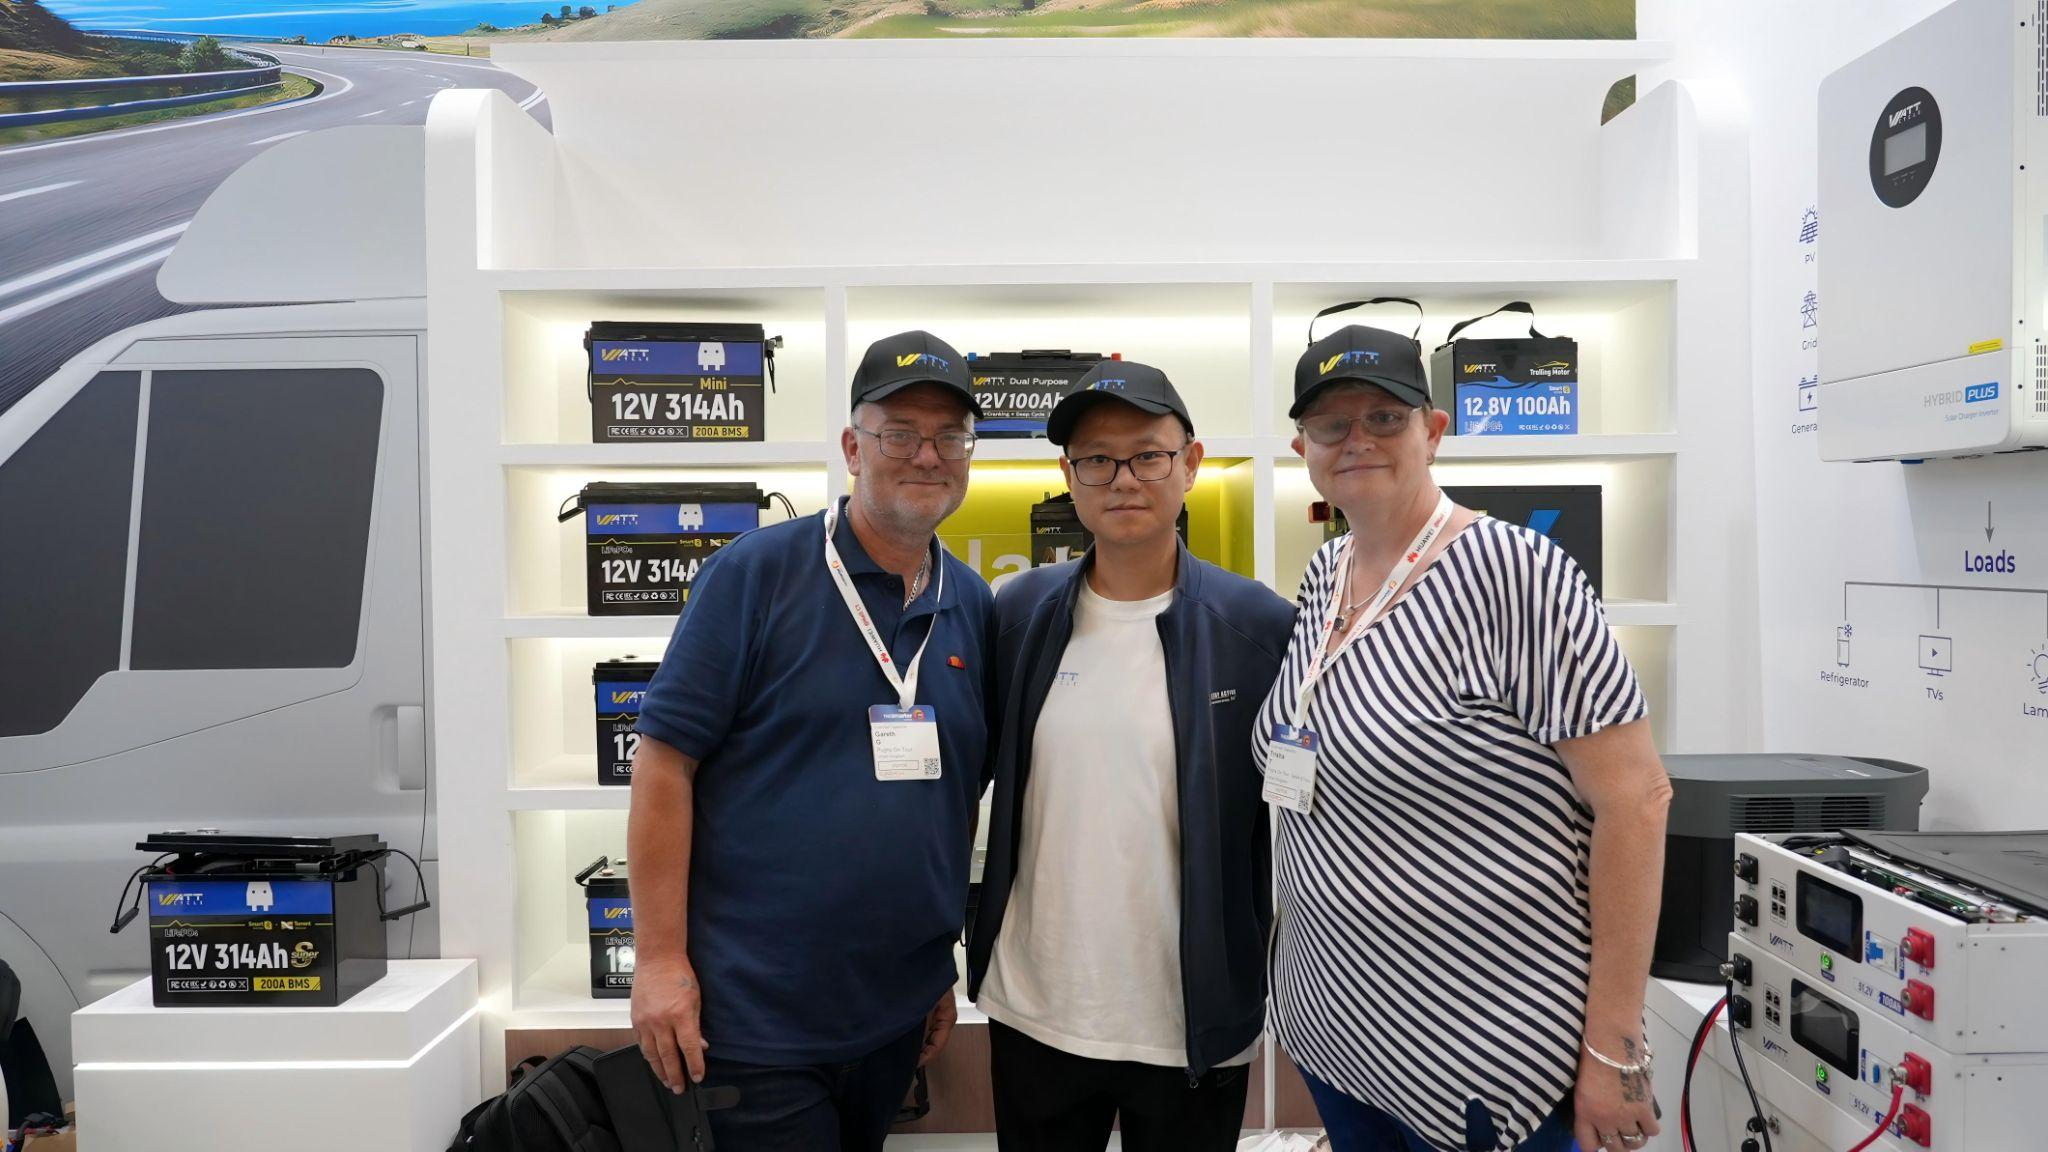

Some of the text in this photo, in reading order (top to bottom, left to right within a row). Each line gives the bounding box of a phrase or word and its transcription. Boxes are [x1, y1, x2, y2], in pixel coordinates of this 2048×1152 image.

[1805, 253, 1815, 263] PV
[1802, 338, 1817, 350] Grid
[1530, 368, 1552, 376] Trolling
[700, 378, 727, 390] Mini
[1009, 377, 1030, 385] Dual
[1032, 378, 1069, 387] Purpose
[1924, 385, 1996, 408] HYBRID PLUS
[612, 393, 744, 420] 12V 314Ah
[1464, 396, 1570, 416] 12.8V 100Ah
[695, 426, 742, 437] 200A BMS
[1416, 529, 1435, 552] HUAWEI
[1965, 549, 2015, 573] Loads
[602, 558, 706, 583] 12V 314A
[1820, 670, 1869, 689] Refrigerator
[1926, 687, 1944, 700] TVs
[614, 733, 645, 760] 12
[165, 943, 208, 970] 12V
[214, 942, 289, 969] 314Ah
[261, 978, 310, 989] 200A BMS
[1858, 981, 1873, 997] 51.2V
[1854, 1098, 1870, 1115] 51.2V
